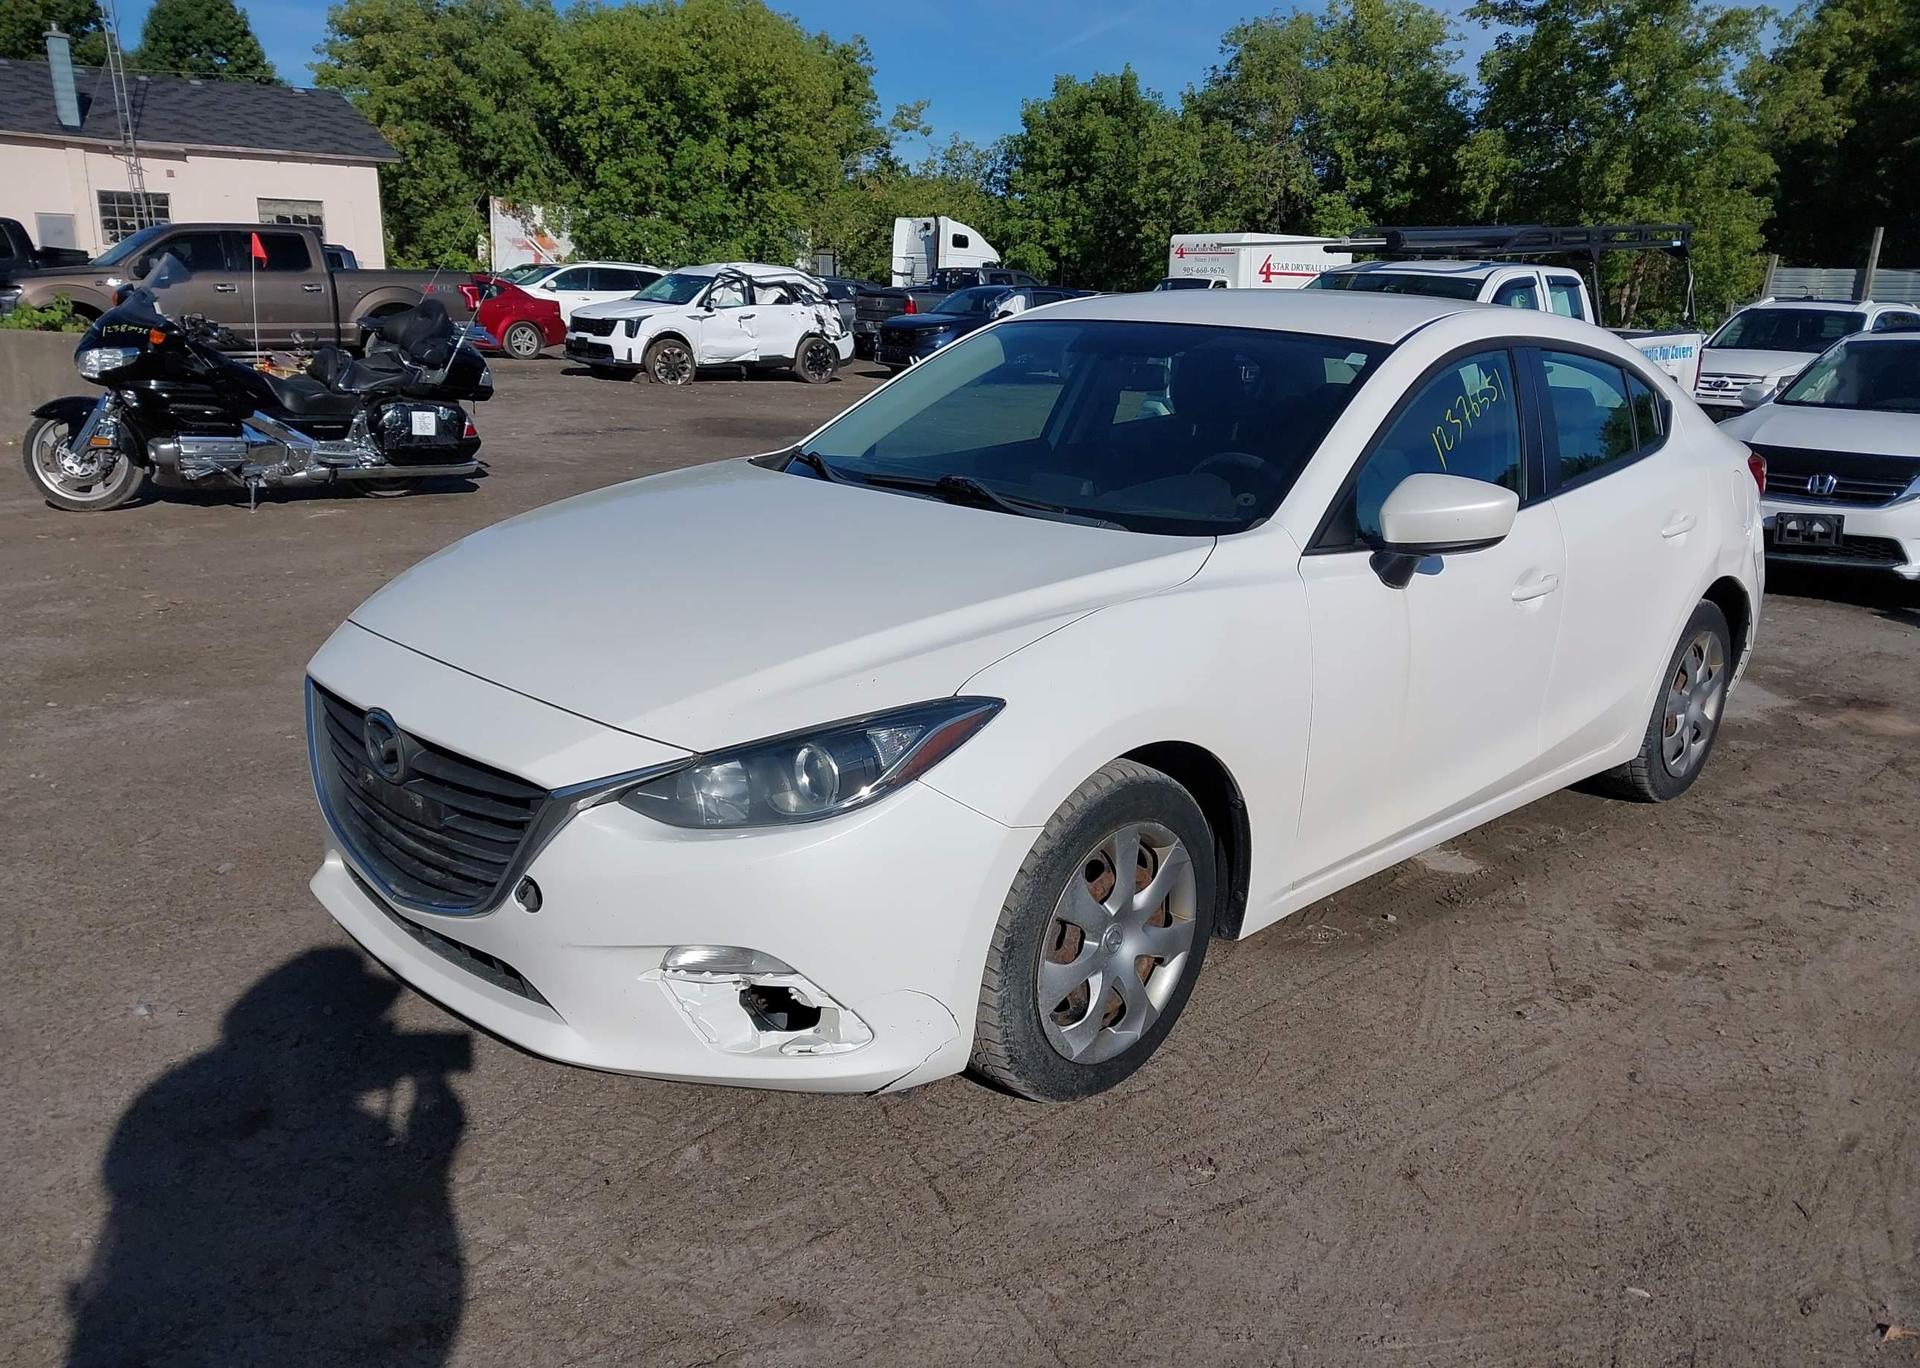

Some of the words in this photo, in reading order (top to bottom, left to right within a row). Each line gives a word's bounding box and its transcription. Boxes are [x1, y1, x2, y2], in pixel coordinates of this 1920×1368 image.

[1174, 243, 1186, 259] 4
[1182, 266, 1225, 274] 905-660-9676
[1258, 254, 1273, 283] 4
[1272, 262, 1290, 271] STAR
[1291, 263, 1322, 272] DRYWALL
[1670, 345, 1693, 360] Covers
